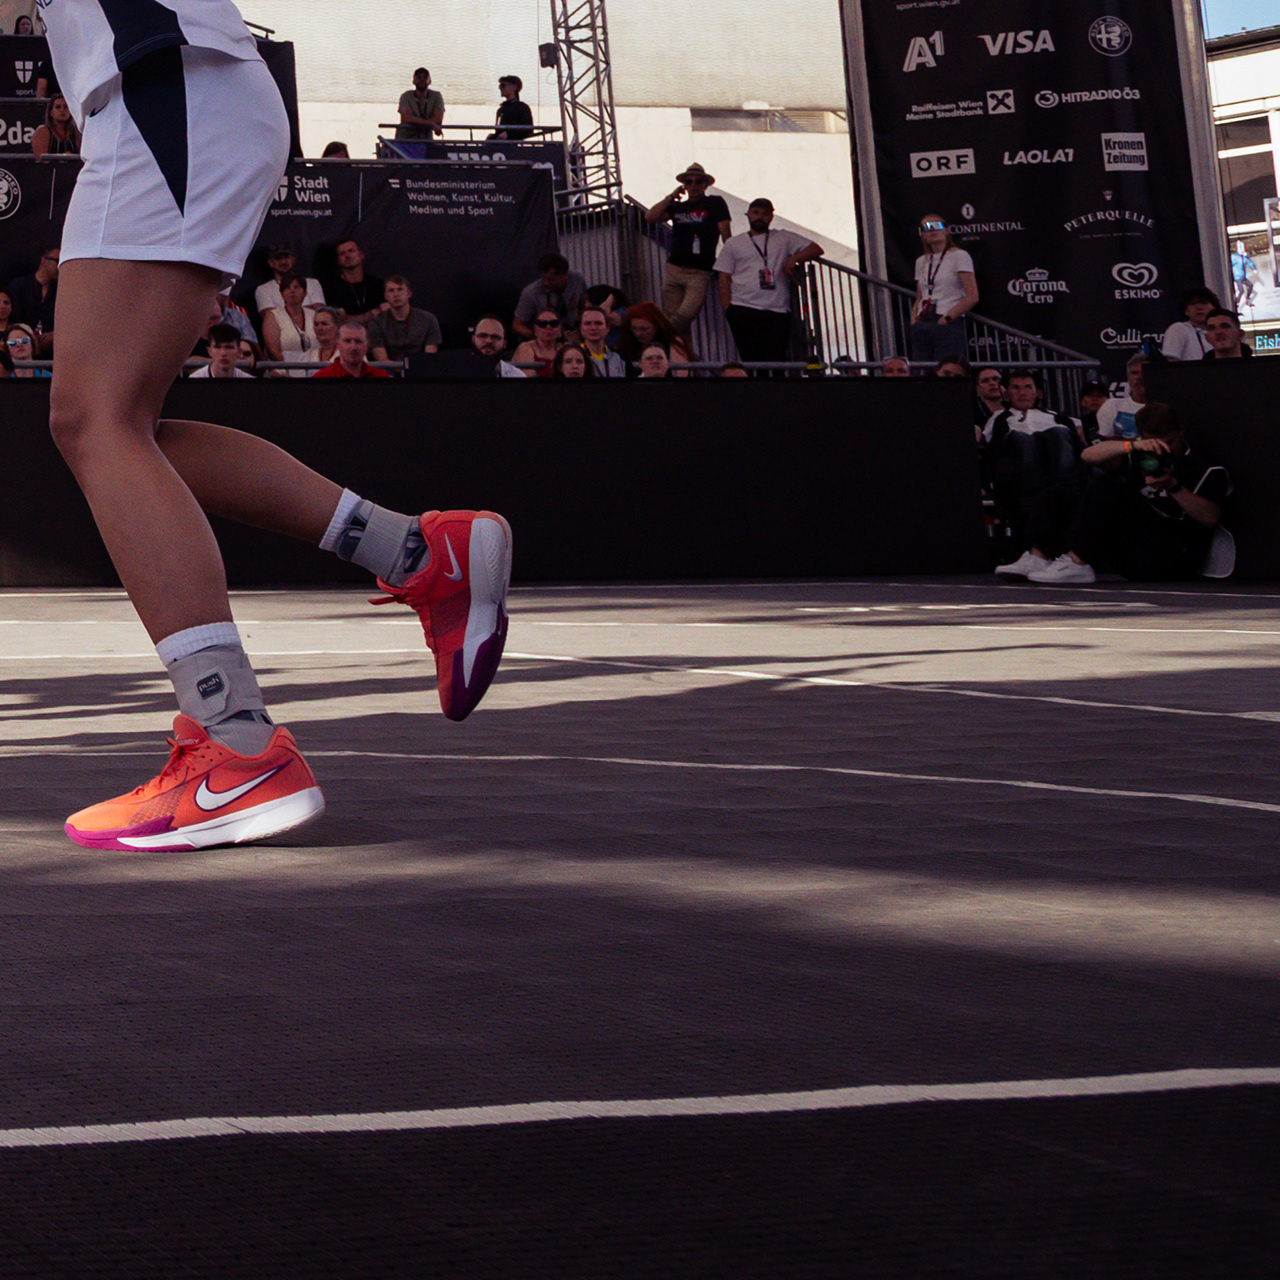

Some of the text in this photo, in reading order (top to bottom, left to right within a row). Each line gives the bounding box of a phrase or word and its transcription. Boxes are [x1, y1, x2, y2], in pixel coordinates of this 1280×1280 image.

[977, 30, 1055, 56] VISA
[903, 30, 945, 72] A1
[1062, 90, 1120, 105] HITRADIO
[1122, 86, 1141, 100] Ö3
[911, 100, 983, 113] Raiffeisen Wien
[905, 108, 984, 122] Meine Stadtbank
[1104, 138, 1144, 151] Kronen
[916, 154, 970, 171] ORF
[1002, 148, 1074, 165] LAOLA1
[1106, 150, 1146, 165] Zeitung
[294, 175, 328, 190] Stadt
[406, 178, 496, 190] Bundesministerium
[295, 190, 331, 203] Wien
[408, 192, 516, 205] Wohnen, Kunst, Kultur,
[271, 206, 333, 218] sport.wien.gv.at
[409, 205, 495, 218] Medien und Sport
[1064, 209, 1156, 232] PETERQUELLE
[1007, 276, 1070, 298] Corona
[1027, 291, 1054, 304] Cero
[1115, 289, 1161, 300] ESKIMO
[199, 676, 219, 692] push
